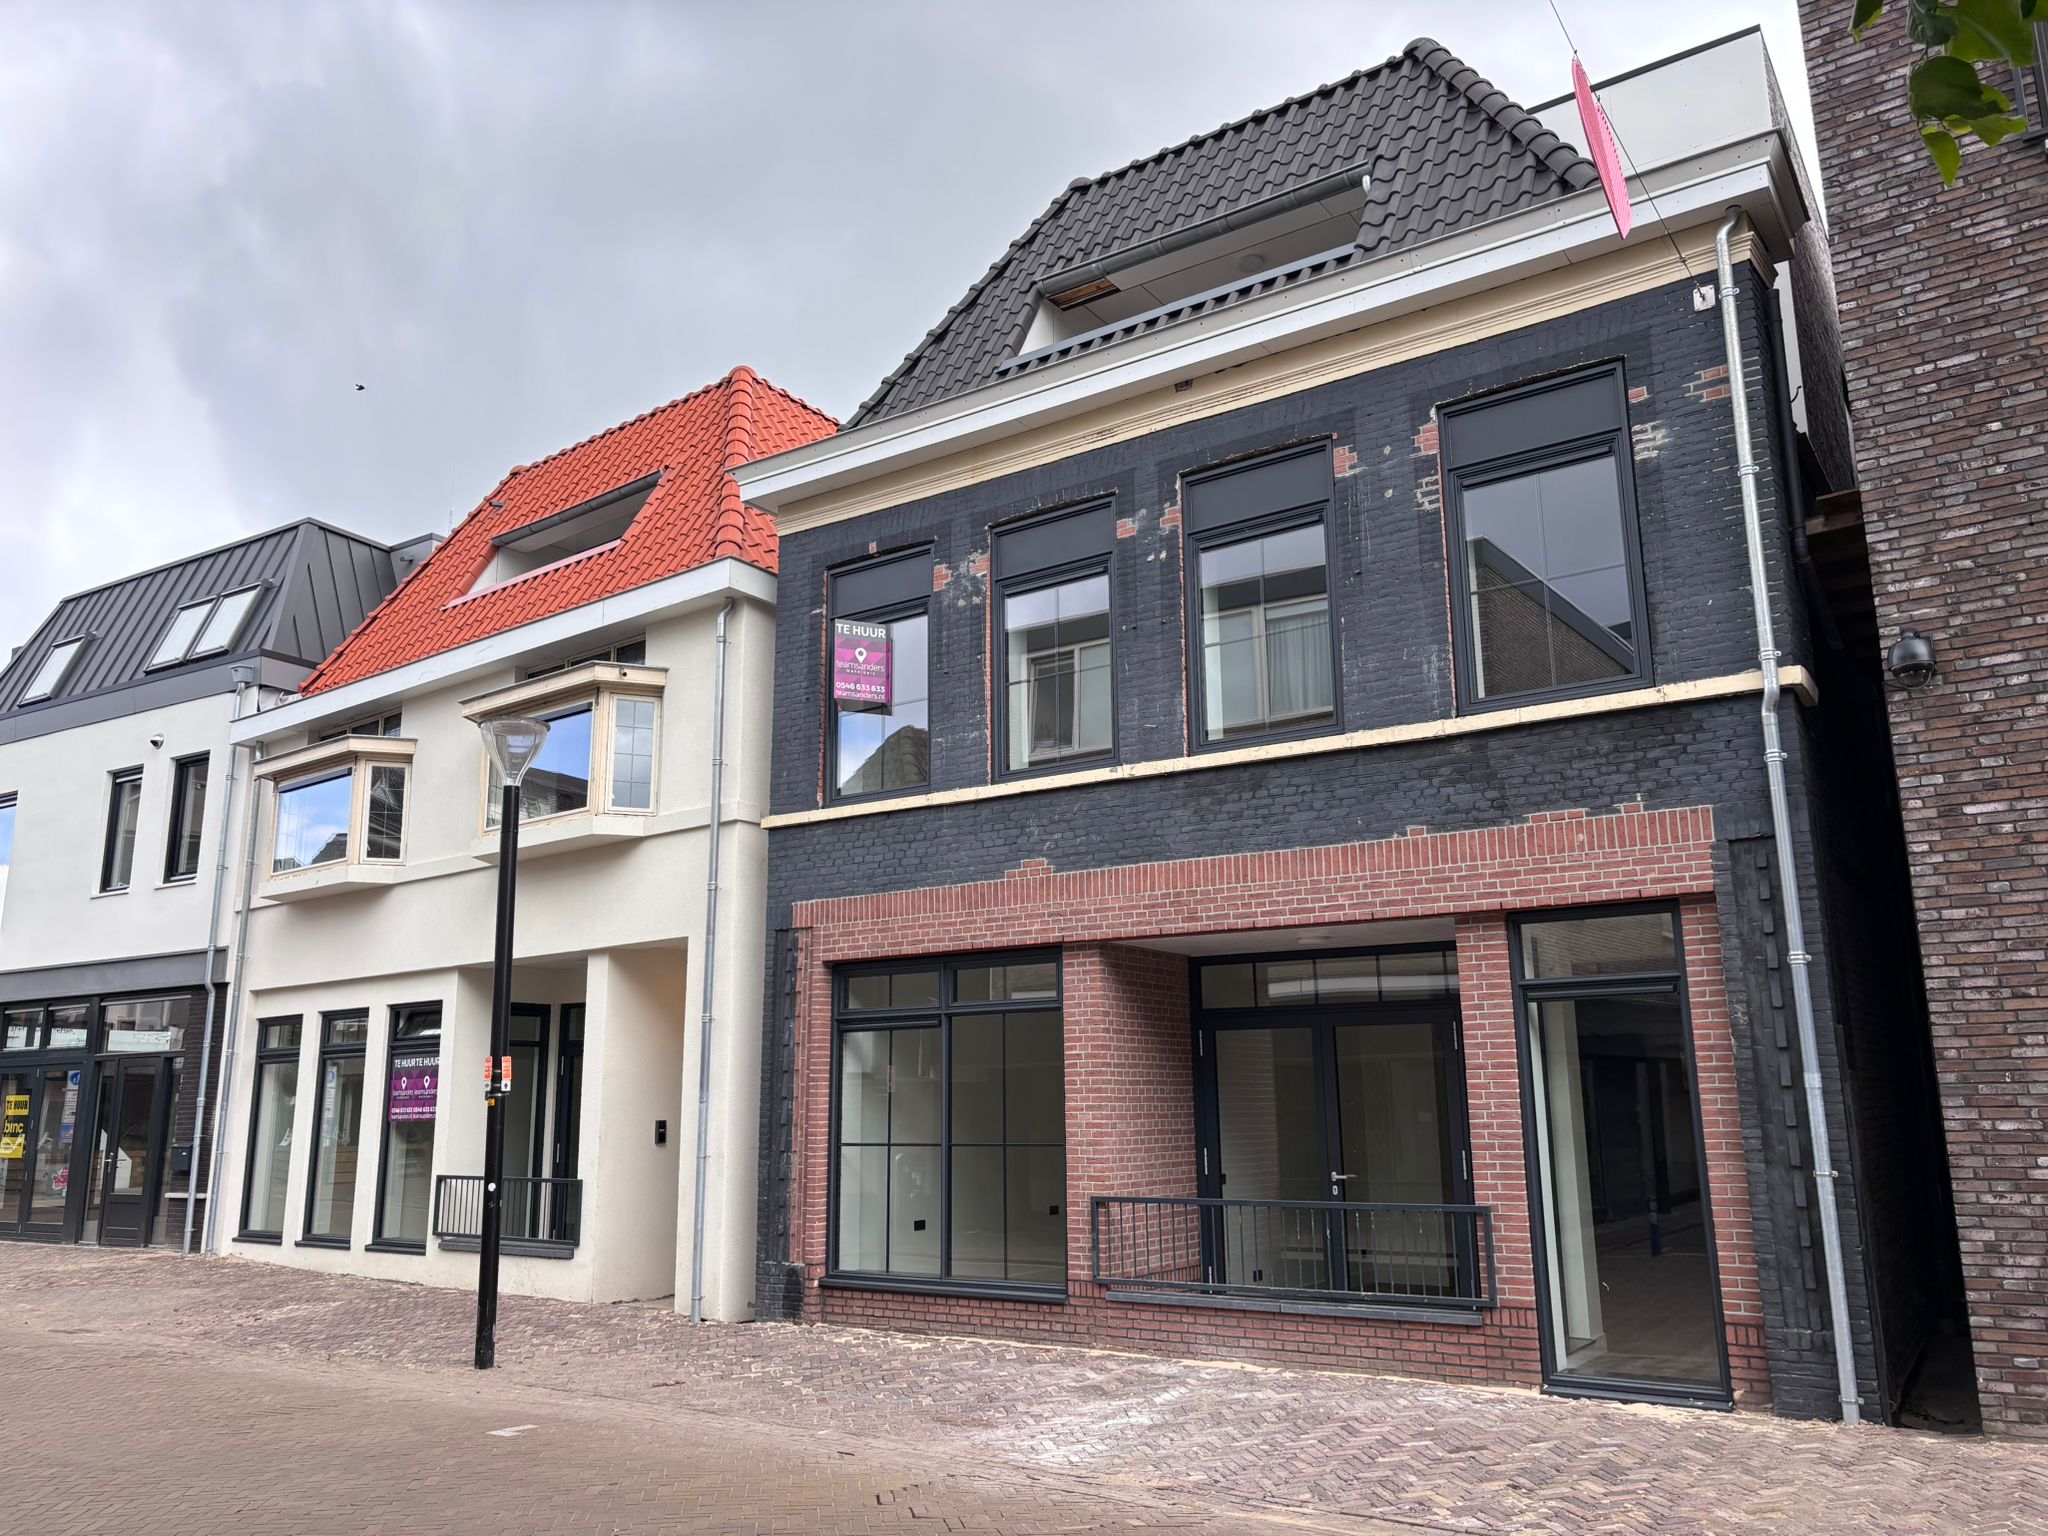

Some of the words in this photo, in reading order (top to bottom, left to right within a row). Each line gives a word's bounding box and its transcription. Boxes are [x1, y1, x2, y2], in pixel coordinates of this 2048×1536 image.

[836, 623, 850, 635] TE
[852, 625, 886, 639] HUUR
[836, 660, 885, 673] teamsanders
[835, 681, 855, 690] 0546
[856, 683, 870, 691] 633
[871, 685, 886, 693] 633
[835, 689, 885, 700] teamsanders.nl
[394, 1059, 401, 1068] TE
[401, 1058, 416, 1067] HUUR
[416, 1057, 423, 1067] TE
[6, 1100, 13, 1110] TE
[13, 1100, 28, 1110] HUUR
